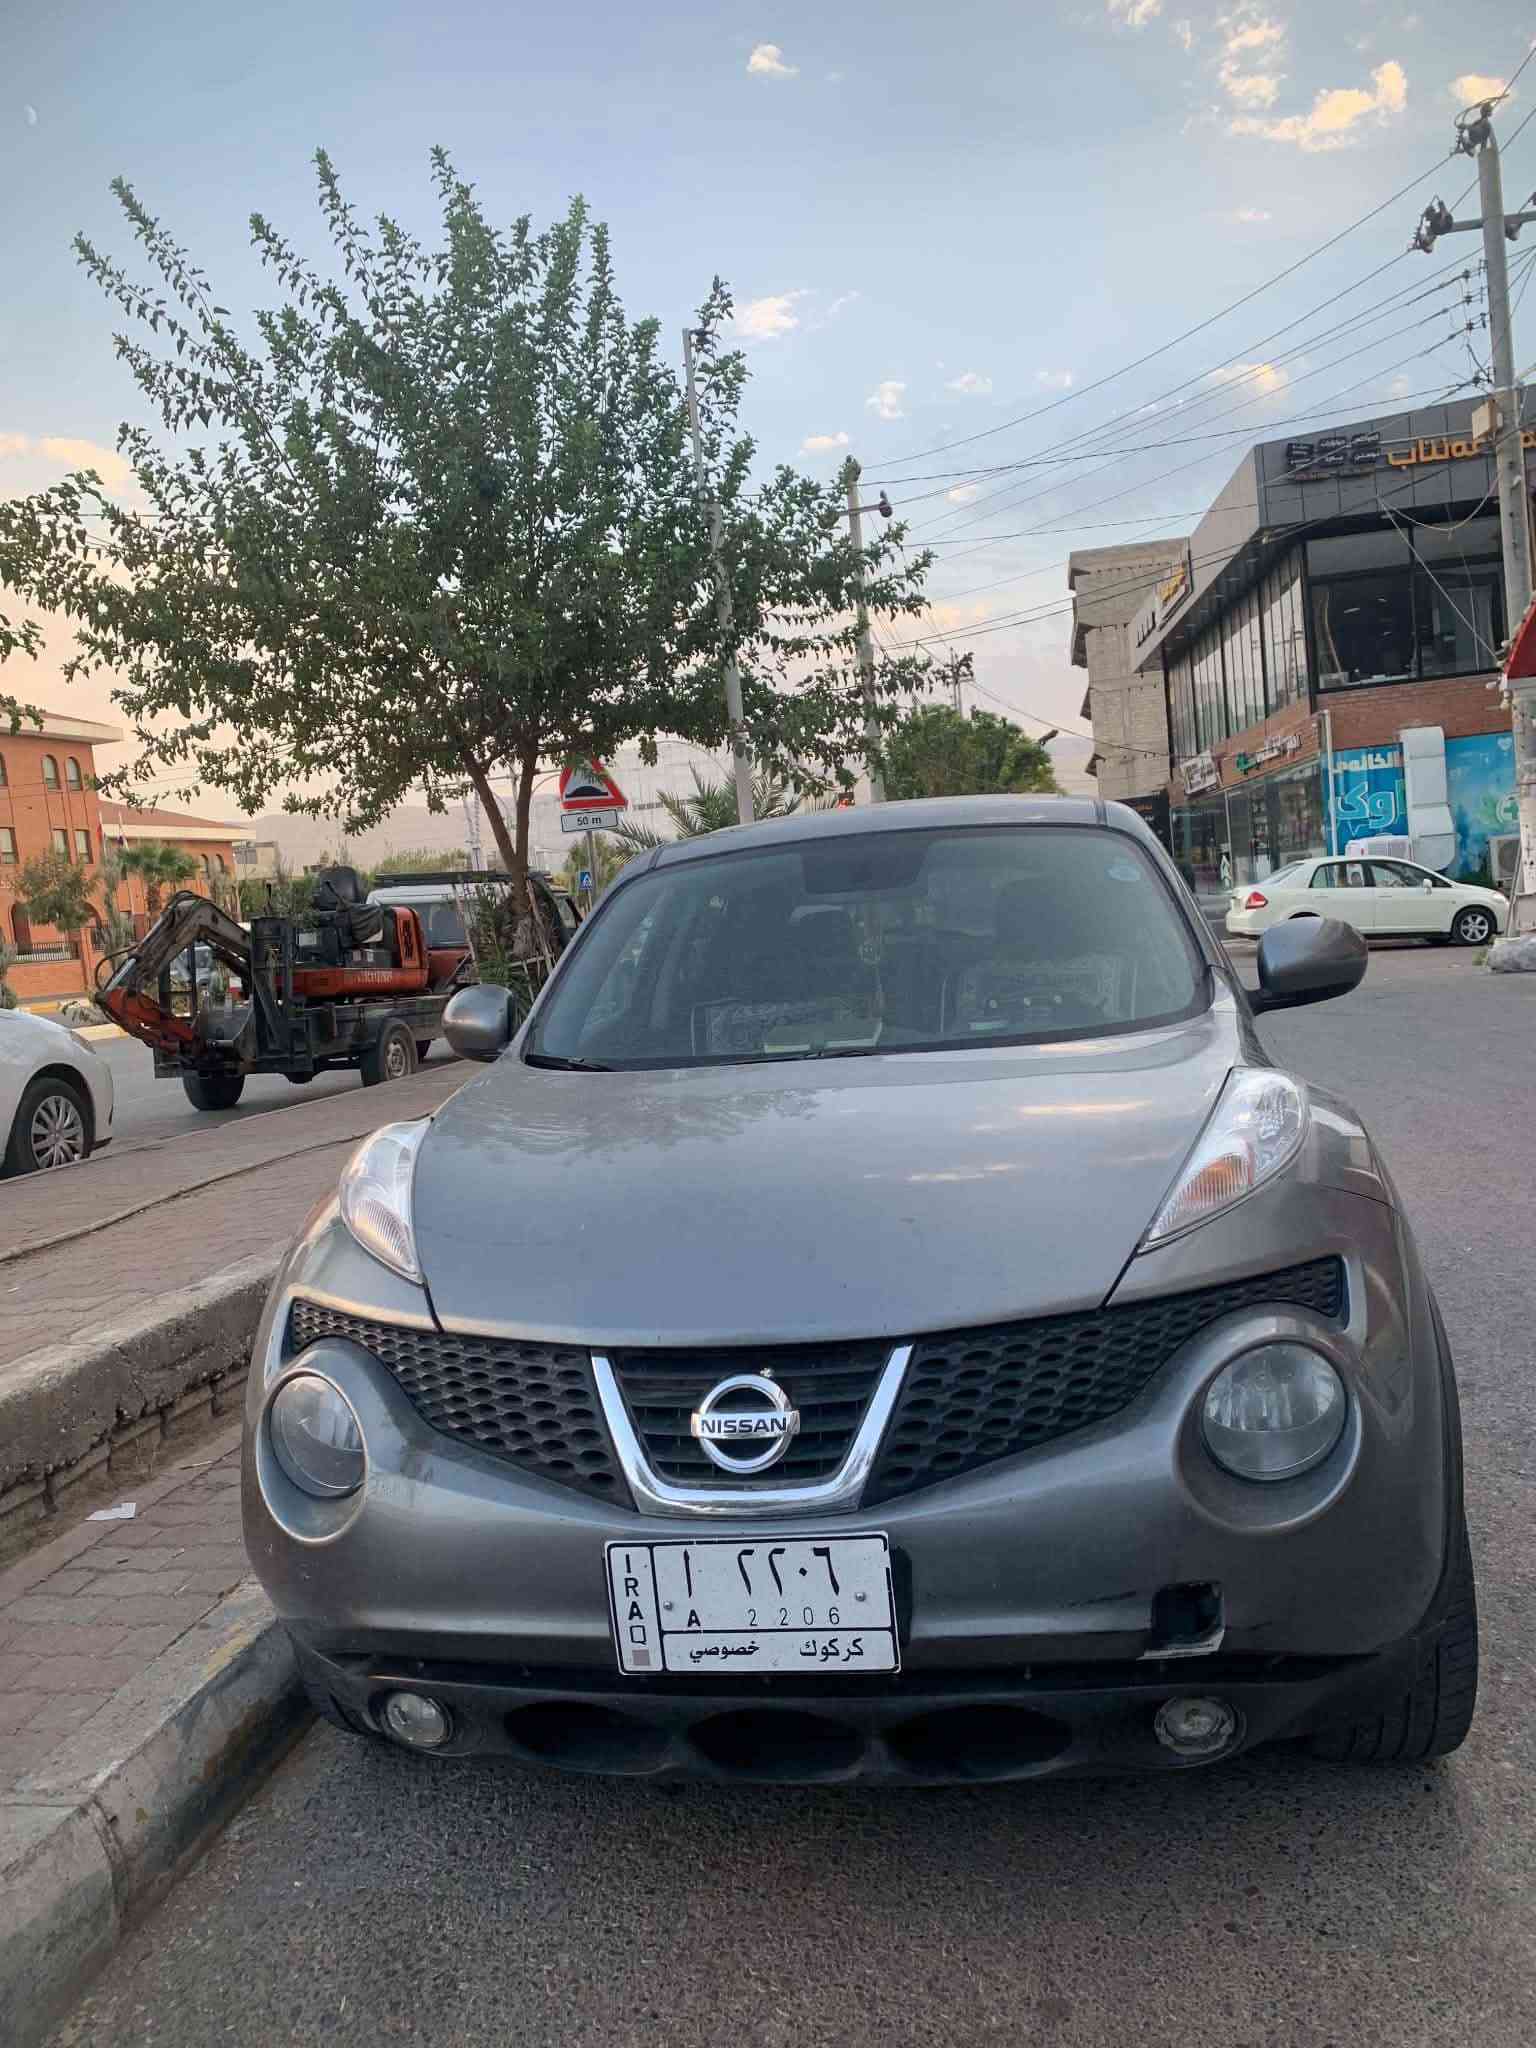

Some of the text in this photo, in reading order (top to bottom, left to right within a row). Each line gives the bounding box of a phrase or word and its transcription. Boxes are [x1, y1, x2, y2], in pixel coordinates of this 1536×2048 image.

[577, 816, 602, 826] 50 m
[701, 1417, 787, 1433] NISSAN
[624, 1553, 647, 1645] IRAQ
[687, 1607, 840, 1627] A 2206
[689, 1638, 864, 1664] كركوك خصوصي
